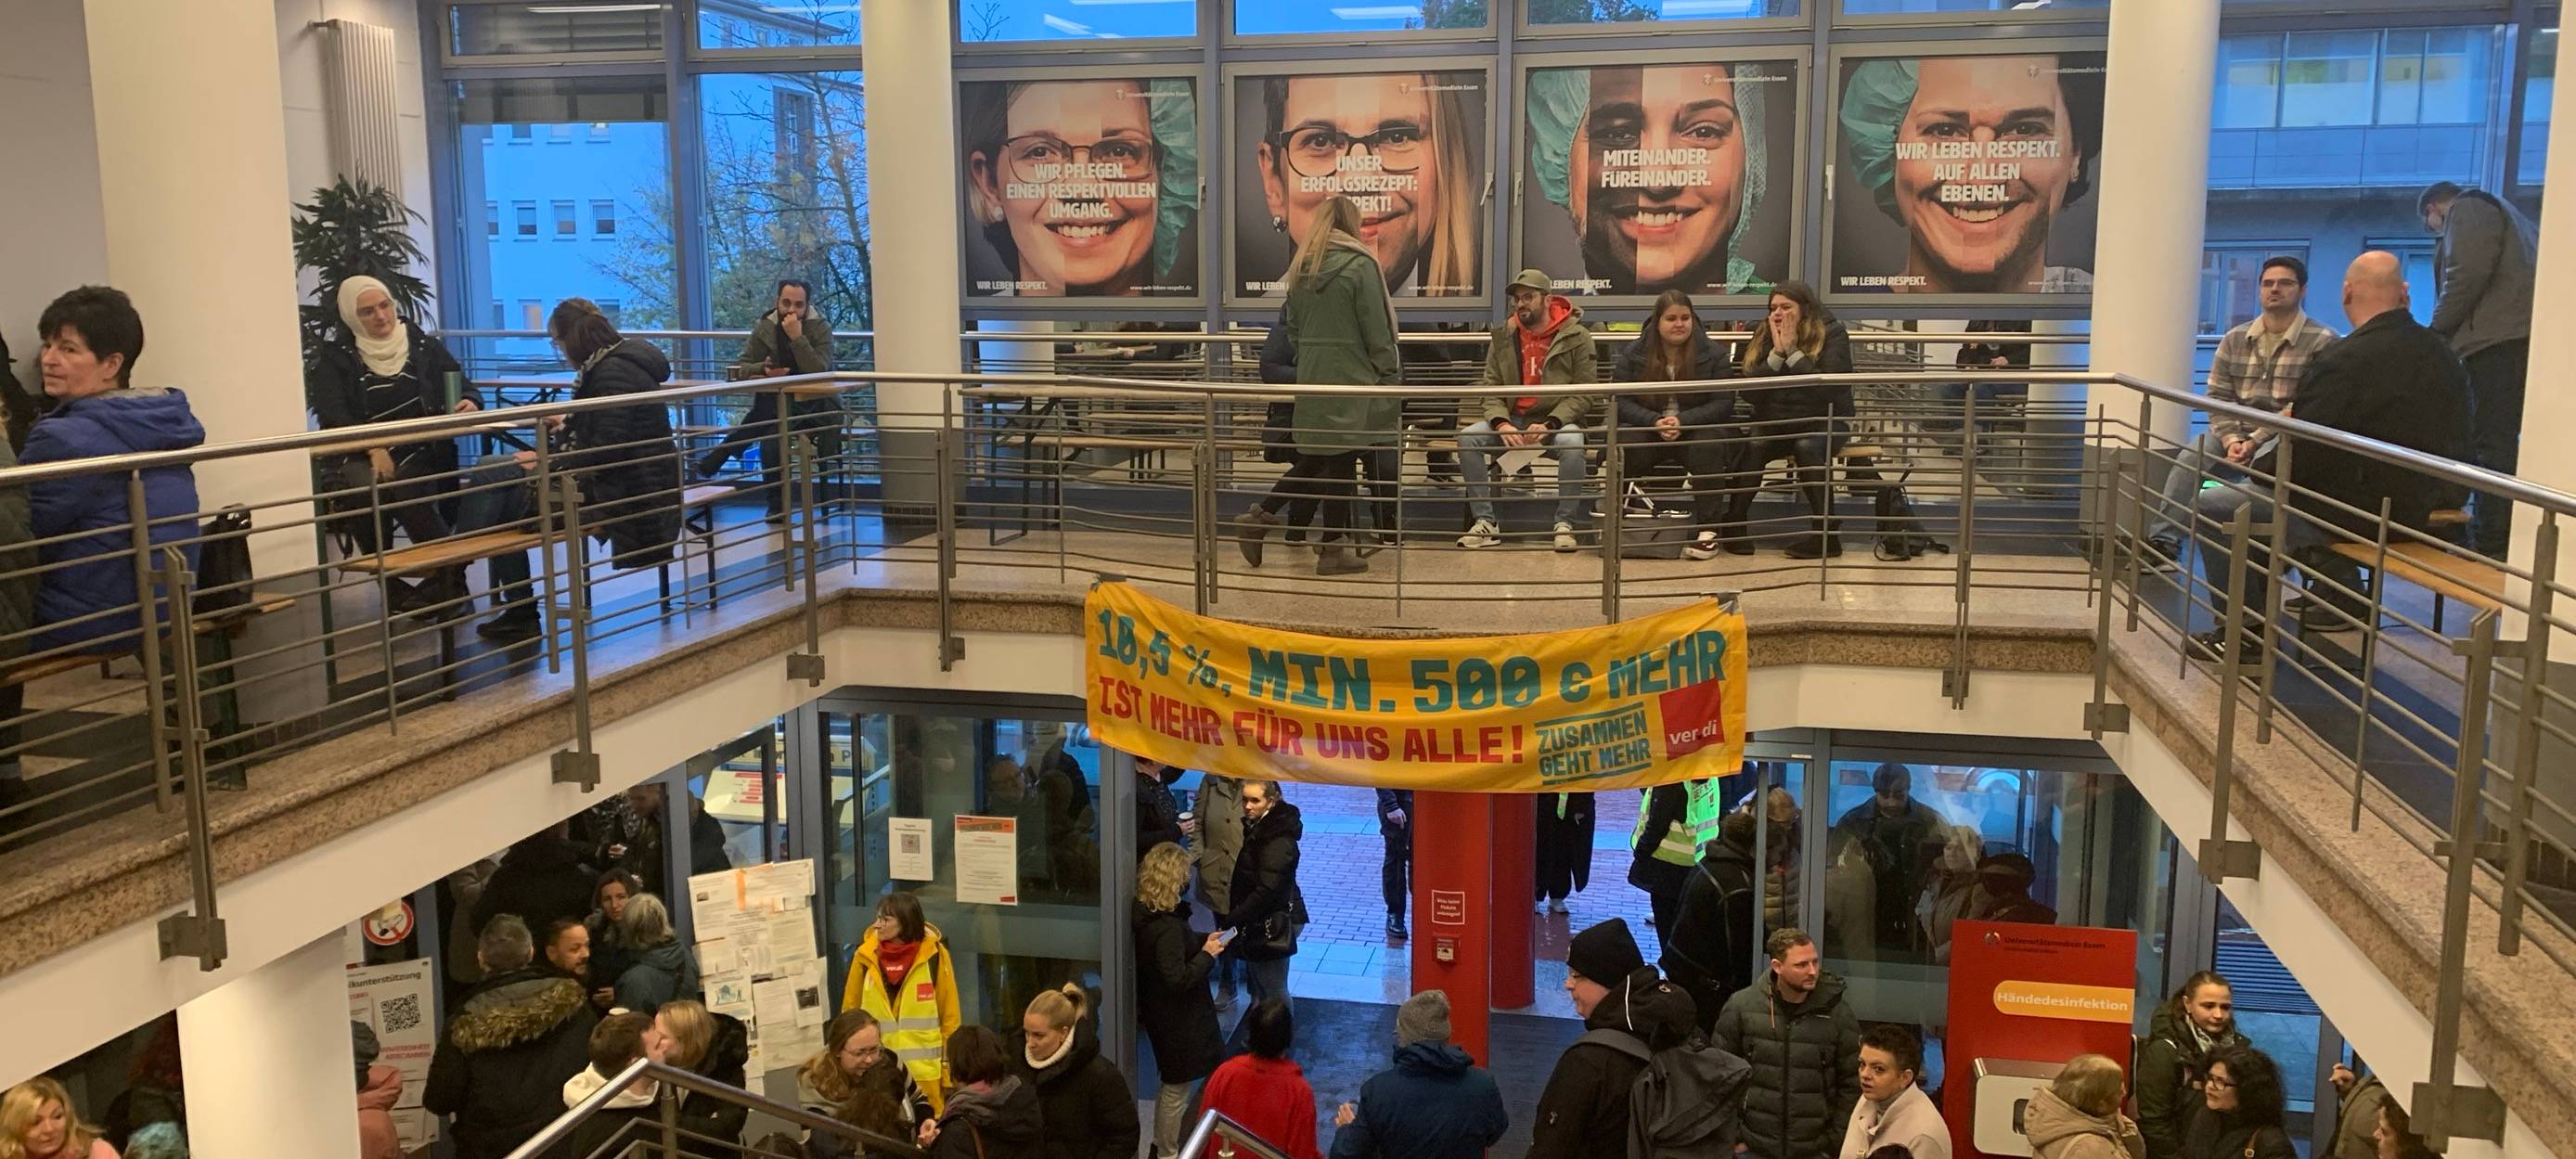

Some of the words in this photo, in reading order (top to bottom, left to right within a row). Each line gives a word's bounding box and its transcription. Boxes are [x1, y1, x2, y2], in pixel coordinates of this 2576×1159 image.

[1604, 148, 1711, 166] MITEINANDER.
[1896, 142, 1927, 160] WIR
[1931, 141, 1981, 159] LEBEN
[1987, 141, 2060, 158] RESPEKT.
[1035, 163, 1062, 178] WIR
[1065, 163, 1127, 178] PFLEGEN.
[1336, 155, 1383, 172] UNSER
[1933, 164, 1965, 181] AUF
[1969, 162, 2020, 180] ALLEN
[1301, 174, 1418, 192] ERFOLGSREZEPT:
[1601, 170, 1712, 187] FÜREINANDER.
[1007, 184, 1046, 199] EINEN
[1049, 183, 1156, 199] RESPEKTVOLLEN
[1941, 185, 2009, 202] EBENEN.
[1050, 202, 1114, 218] UMGANG.
[1326, 196, 1391, 212] PEKT!
[976, 281, 991, 290] WIR
[992, 281, 1014, 290] LEBEN
[1015, 281, 1048, 290] RESPEKT.
[1245, 281, 1261, 290] WIR
[1262, 281, 1285, 290] LEBEN
[1550, 279, 1575, 290] LEBEN
[1576, 278, 1612, 290] RESPEKT.
[1841, 277, 1858, 286] WIR
[1859, 277, 1887, 286] LEBEN
[1887, 276, 1926, 286] RESPEKT.
[1099, 609, 1171, 679] 10,5
[1182, 644, 1231, 698] %,
[1248, 647, 1396, 713] MIN.
[1410, 656, 1540, 713] 500
[1560, 662, 1592, 702] €
[1607, 630, 1726, 699] MEHR
[1099, 676, 1142, 724] IST
[1150, 692, 1222, 744] MEHR
[1233, 707, 1304, 756] FÜR
[1315, 722, 1390, 762] UNS
[1536, 710, 1647, 754] ZUSAMMEN
[1539, 750, 1592, 778] GEHT
[1598, 738, 1652, 770] MEHR
[349, 972, 421, 988] ikunterstützung
[1997, 992, 2128, 1011] Händedesinfektion
